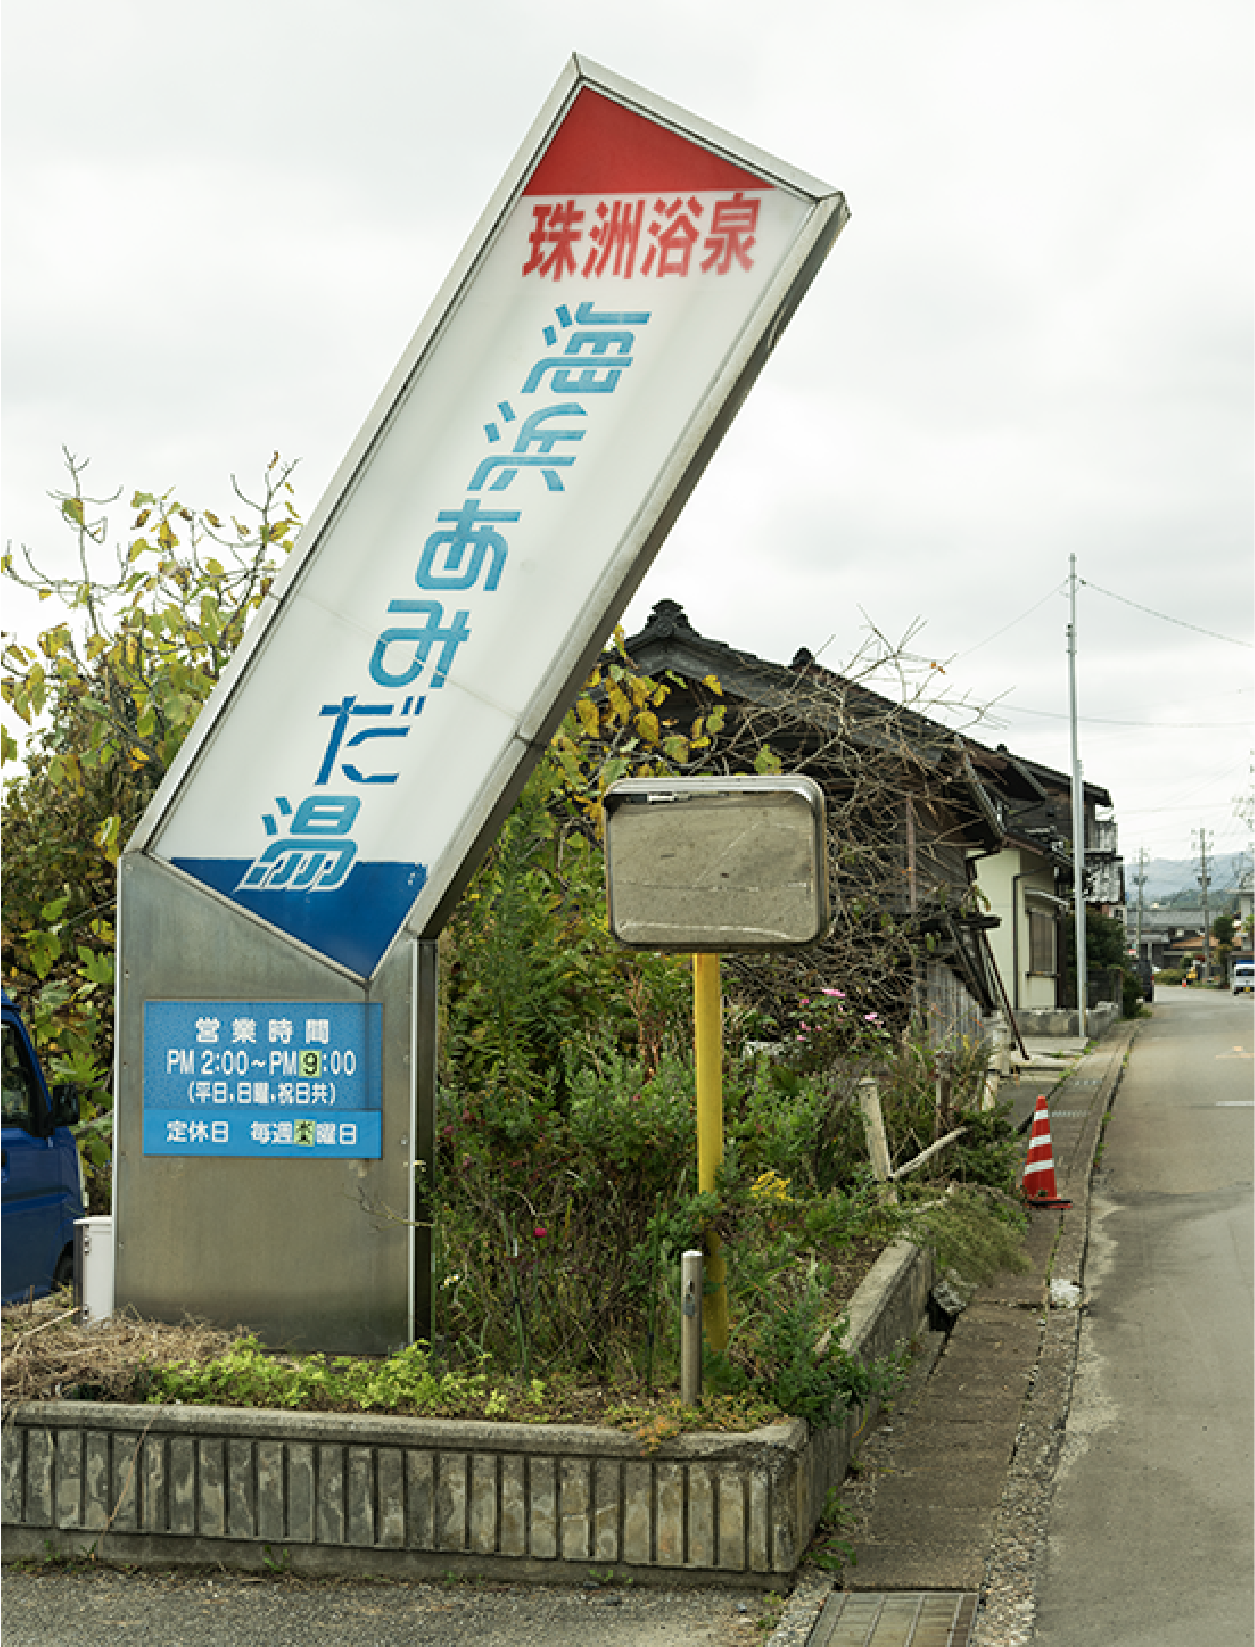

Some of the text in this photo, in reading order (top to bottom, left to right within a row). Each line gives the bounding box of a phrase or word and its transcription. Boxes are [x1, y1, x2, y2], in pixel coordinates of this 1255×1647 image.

[522, 193, 762, 282] 珠洲浴泉
[235, 301, 652, 892] 海浜あみだ湯
[195, 1017, 329, 1044] 営業時間
[166, 1050, 195, 1075] PM
[166, 1119, 229, 1143] 定休日
